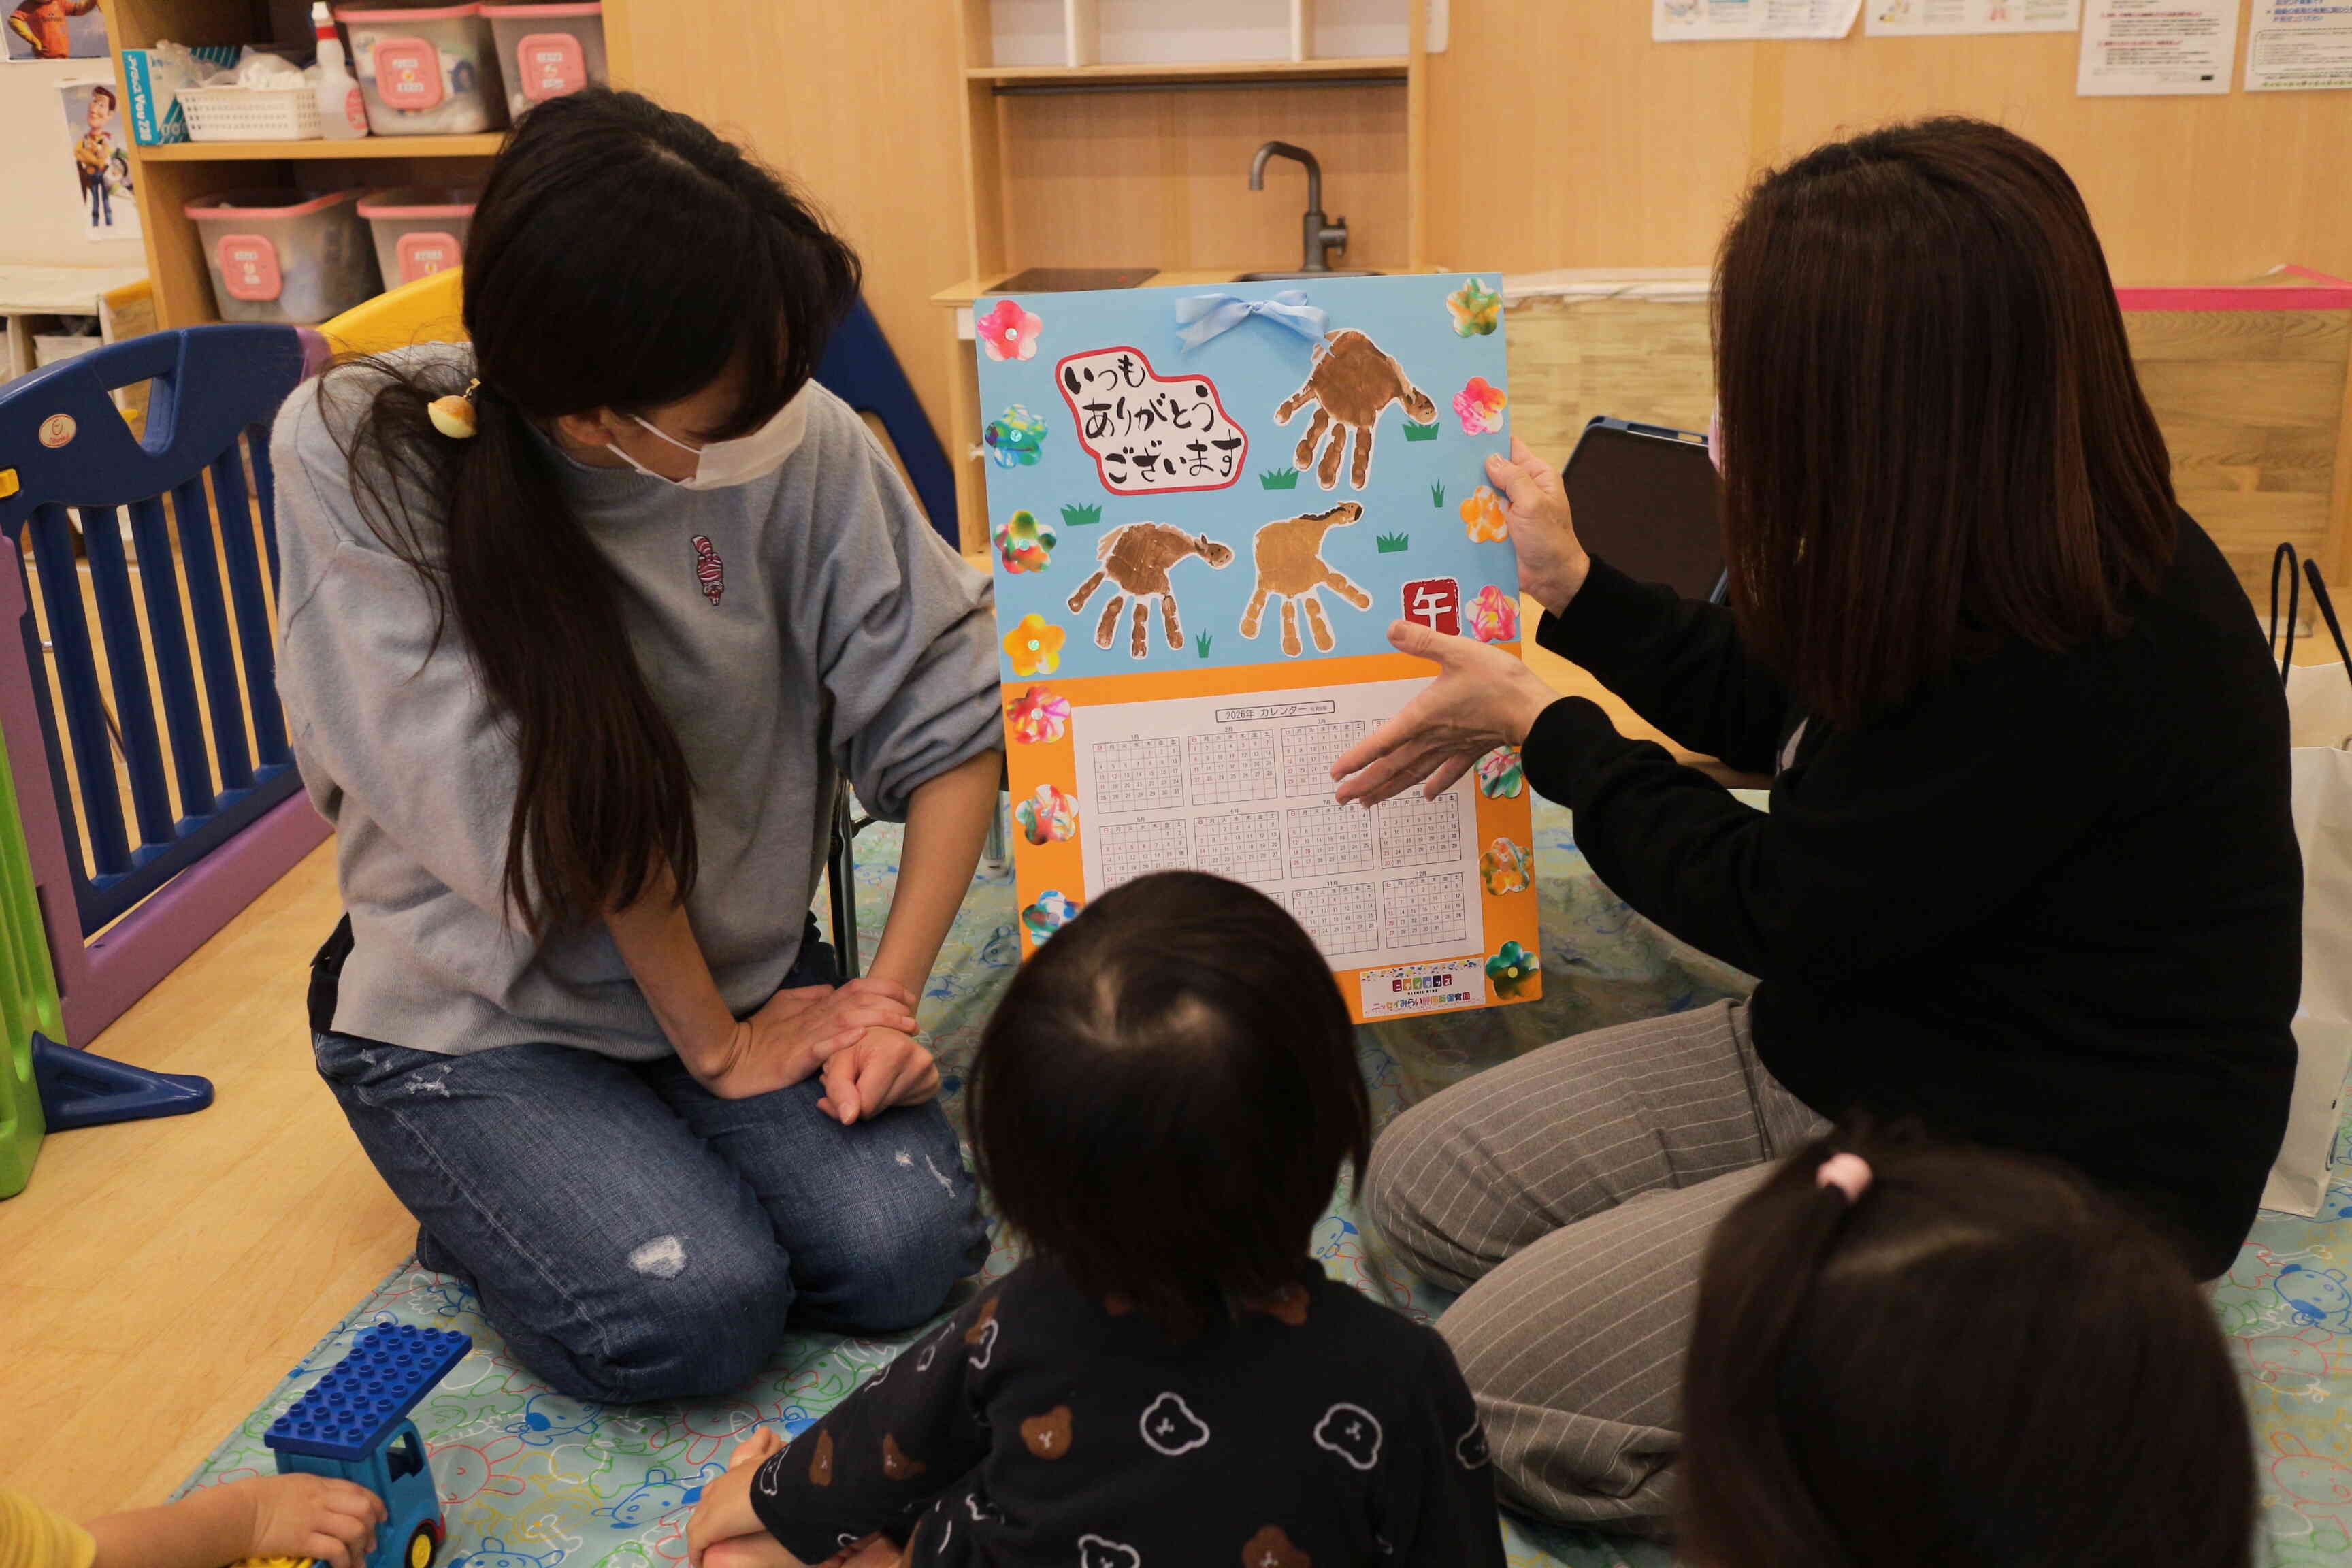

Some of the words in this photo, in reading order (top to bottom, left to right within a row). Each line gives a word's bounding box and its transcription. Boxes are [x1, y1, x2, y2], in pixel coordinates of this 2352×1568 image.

[1064, 354, 1145, 395] いつも
[1081, 385, 1215, 439] ありがとう
[1105, 429, 1242, 484] ございます
[1226, 709, 1255, 720] 2026年
[1260, 705, 1307, 717] カレンダー
